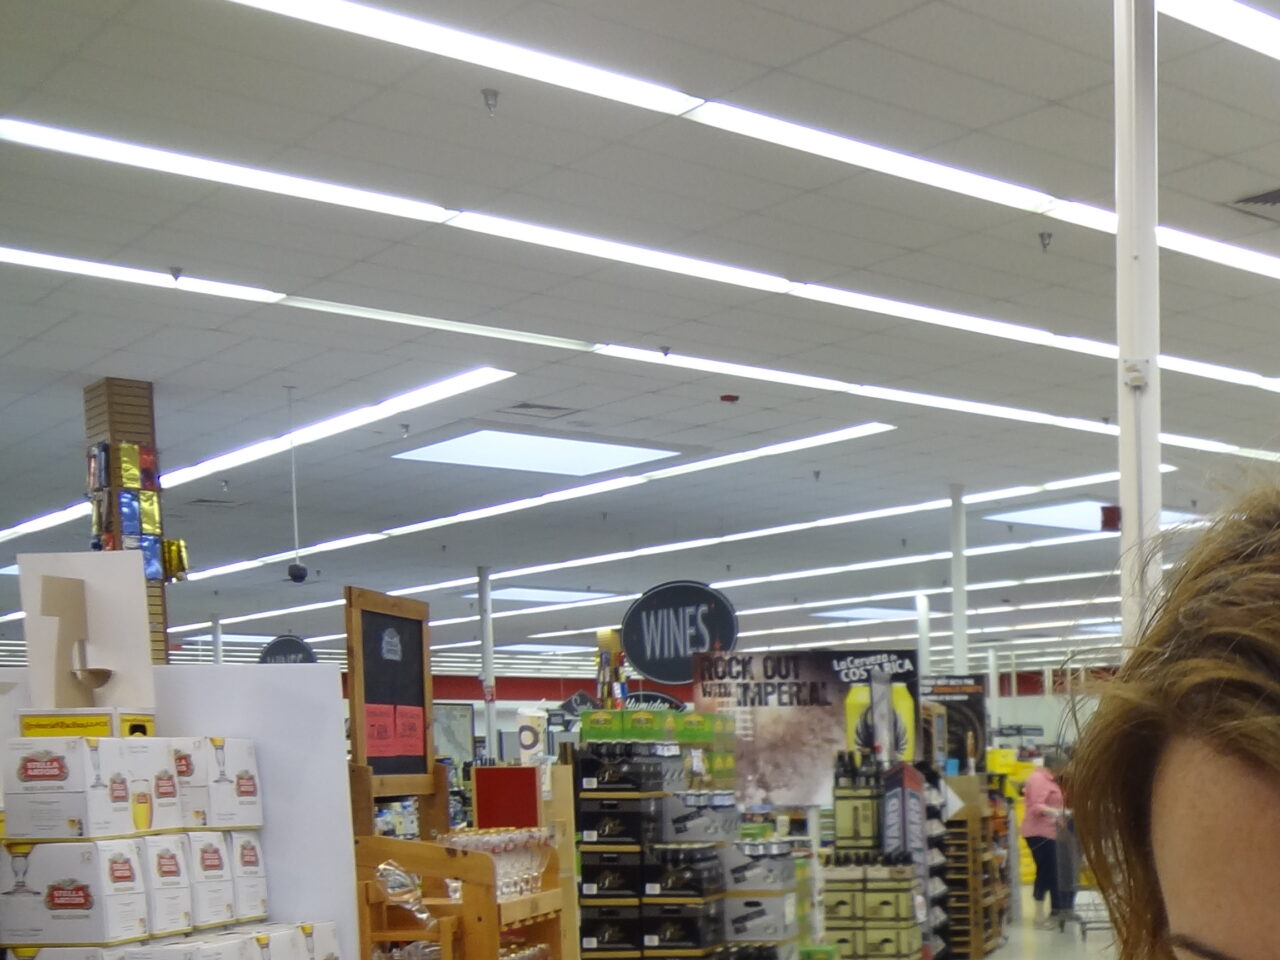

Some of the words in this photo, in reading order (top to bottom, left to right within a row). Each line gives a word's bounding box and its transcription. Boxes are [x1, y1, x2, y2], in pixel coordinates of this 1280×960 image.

[641, 604, 711, 660] WINES
[702, 656, 754, 681] ROCK
[763, 655, 801, 680] OUT
[883, 658, 915, 675] RICA
